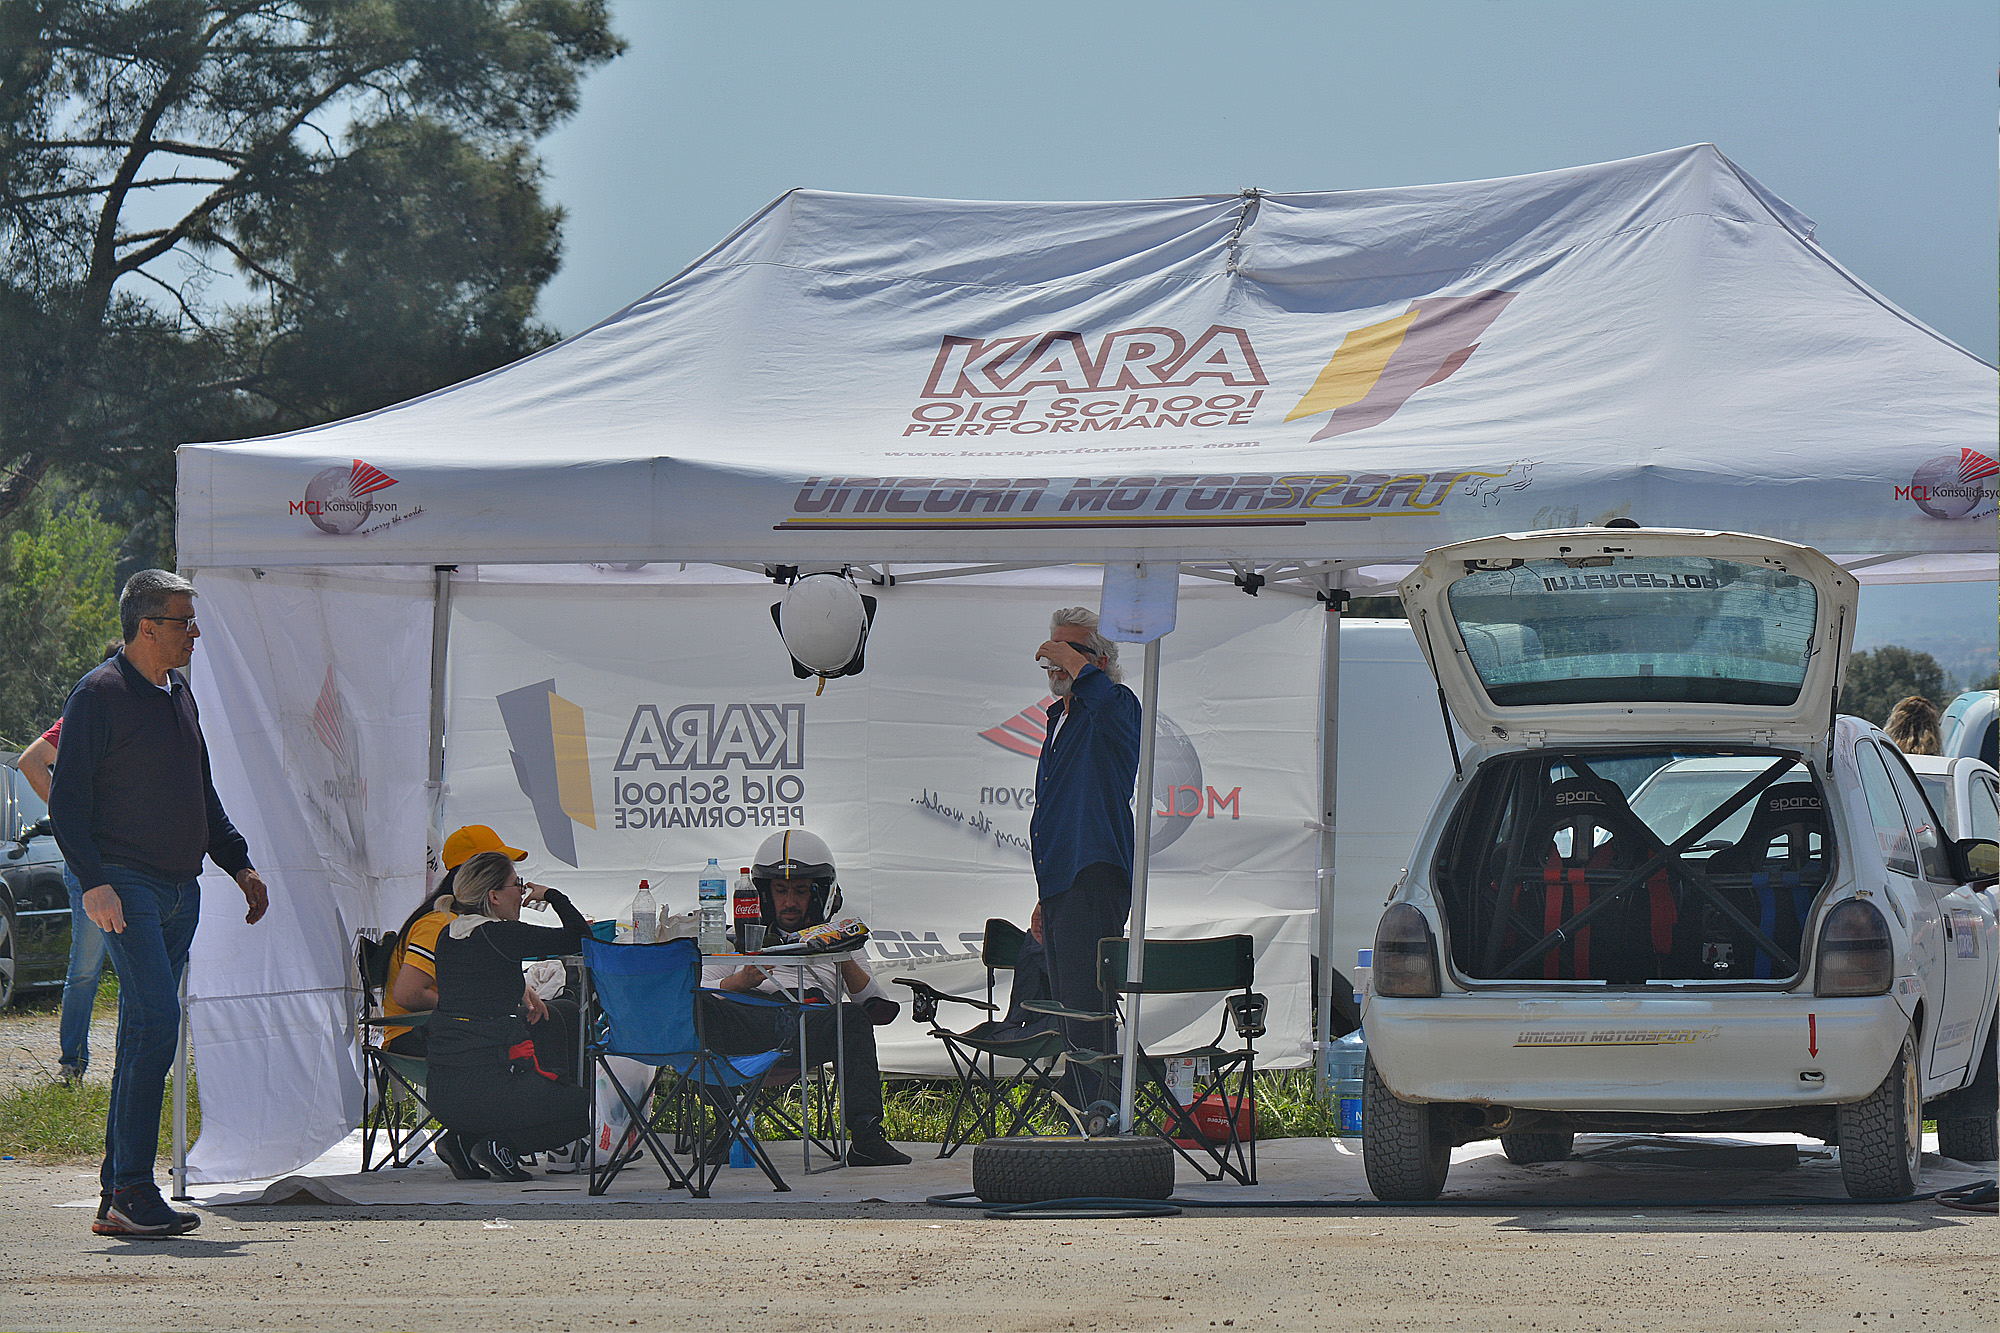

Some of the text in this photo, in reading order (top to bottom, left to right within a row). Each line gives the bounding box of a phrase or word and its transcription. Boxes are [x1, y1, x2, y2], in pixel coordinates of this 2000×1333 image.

[919, 324, 1270, 399] KARA
[911, 390, 1264, 422] Old School
[902, 410, 1254, 437] PERFORMANCE
[794, 473, 1459, 513] UNICORN MOTORSPORT
[1894, 486, 1999, 500] MCL Konsolidasyo
[288, 500, 397, 515] MCL Konsolidasyon
[1555, 791, 1603, 805] sparc
[1517, 1029, 1702, 1043] UNICORN MOTORSPORT
